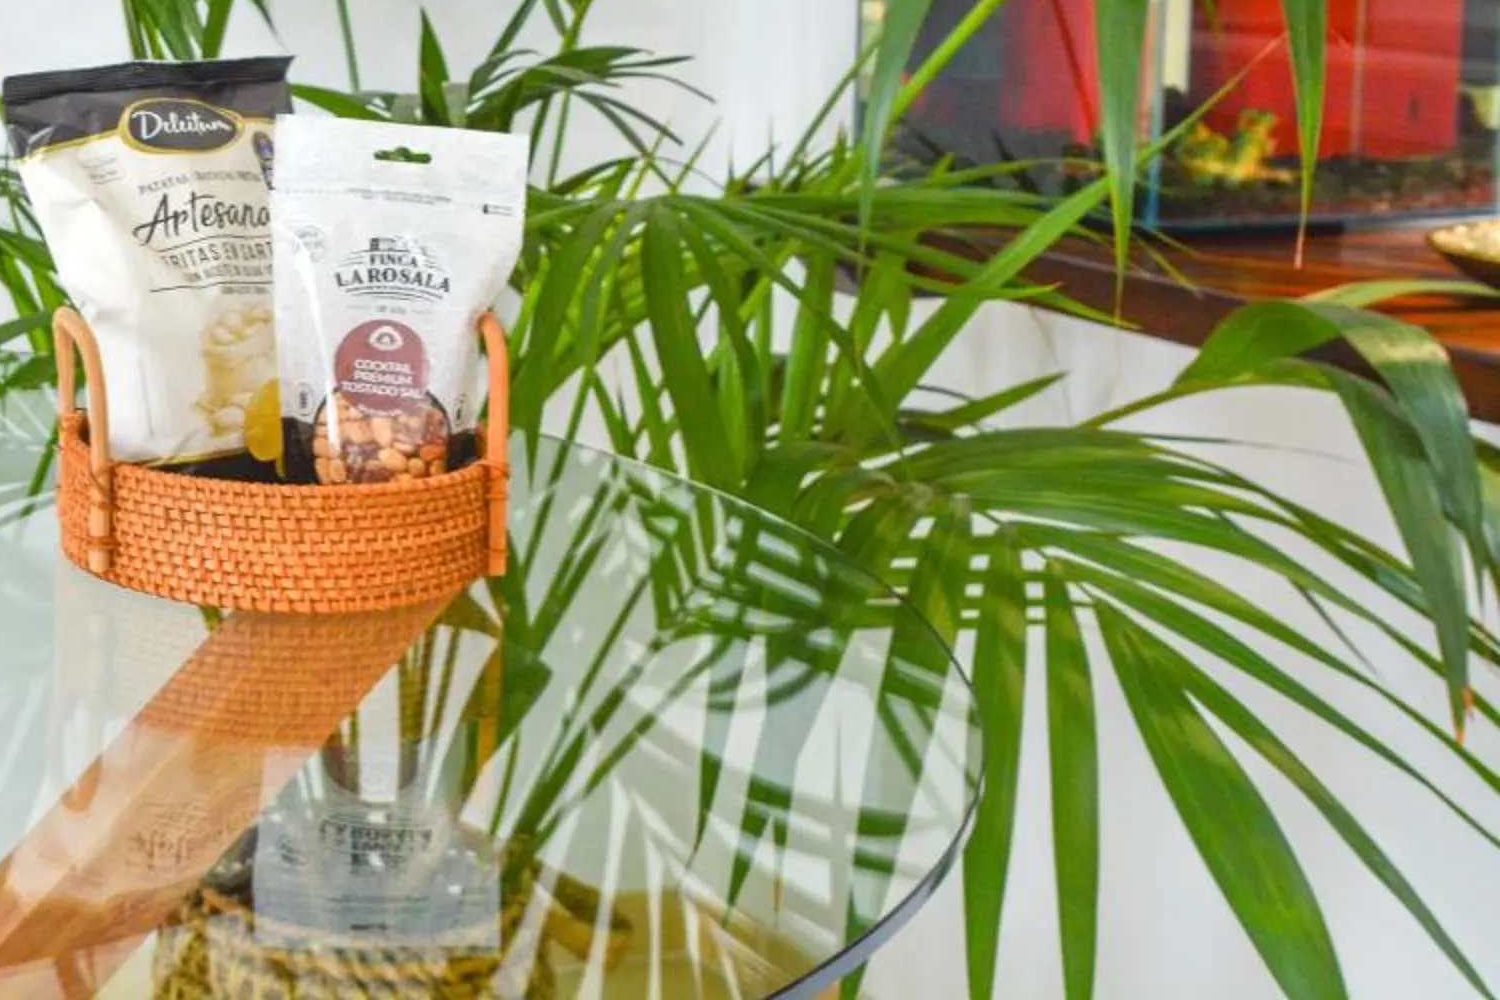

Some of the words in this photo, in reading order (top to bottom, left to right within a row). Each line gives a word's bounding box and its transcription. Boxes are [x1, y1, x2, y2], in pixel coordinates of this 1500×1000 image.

[369, 253, 418, 267] FINCA
[353, 370, 412, 384] PREMIUM
[341, 381, 398, 396] TOSTADO
